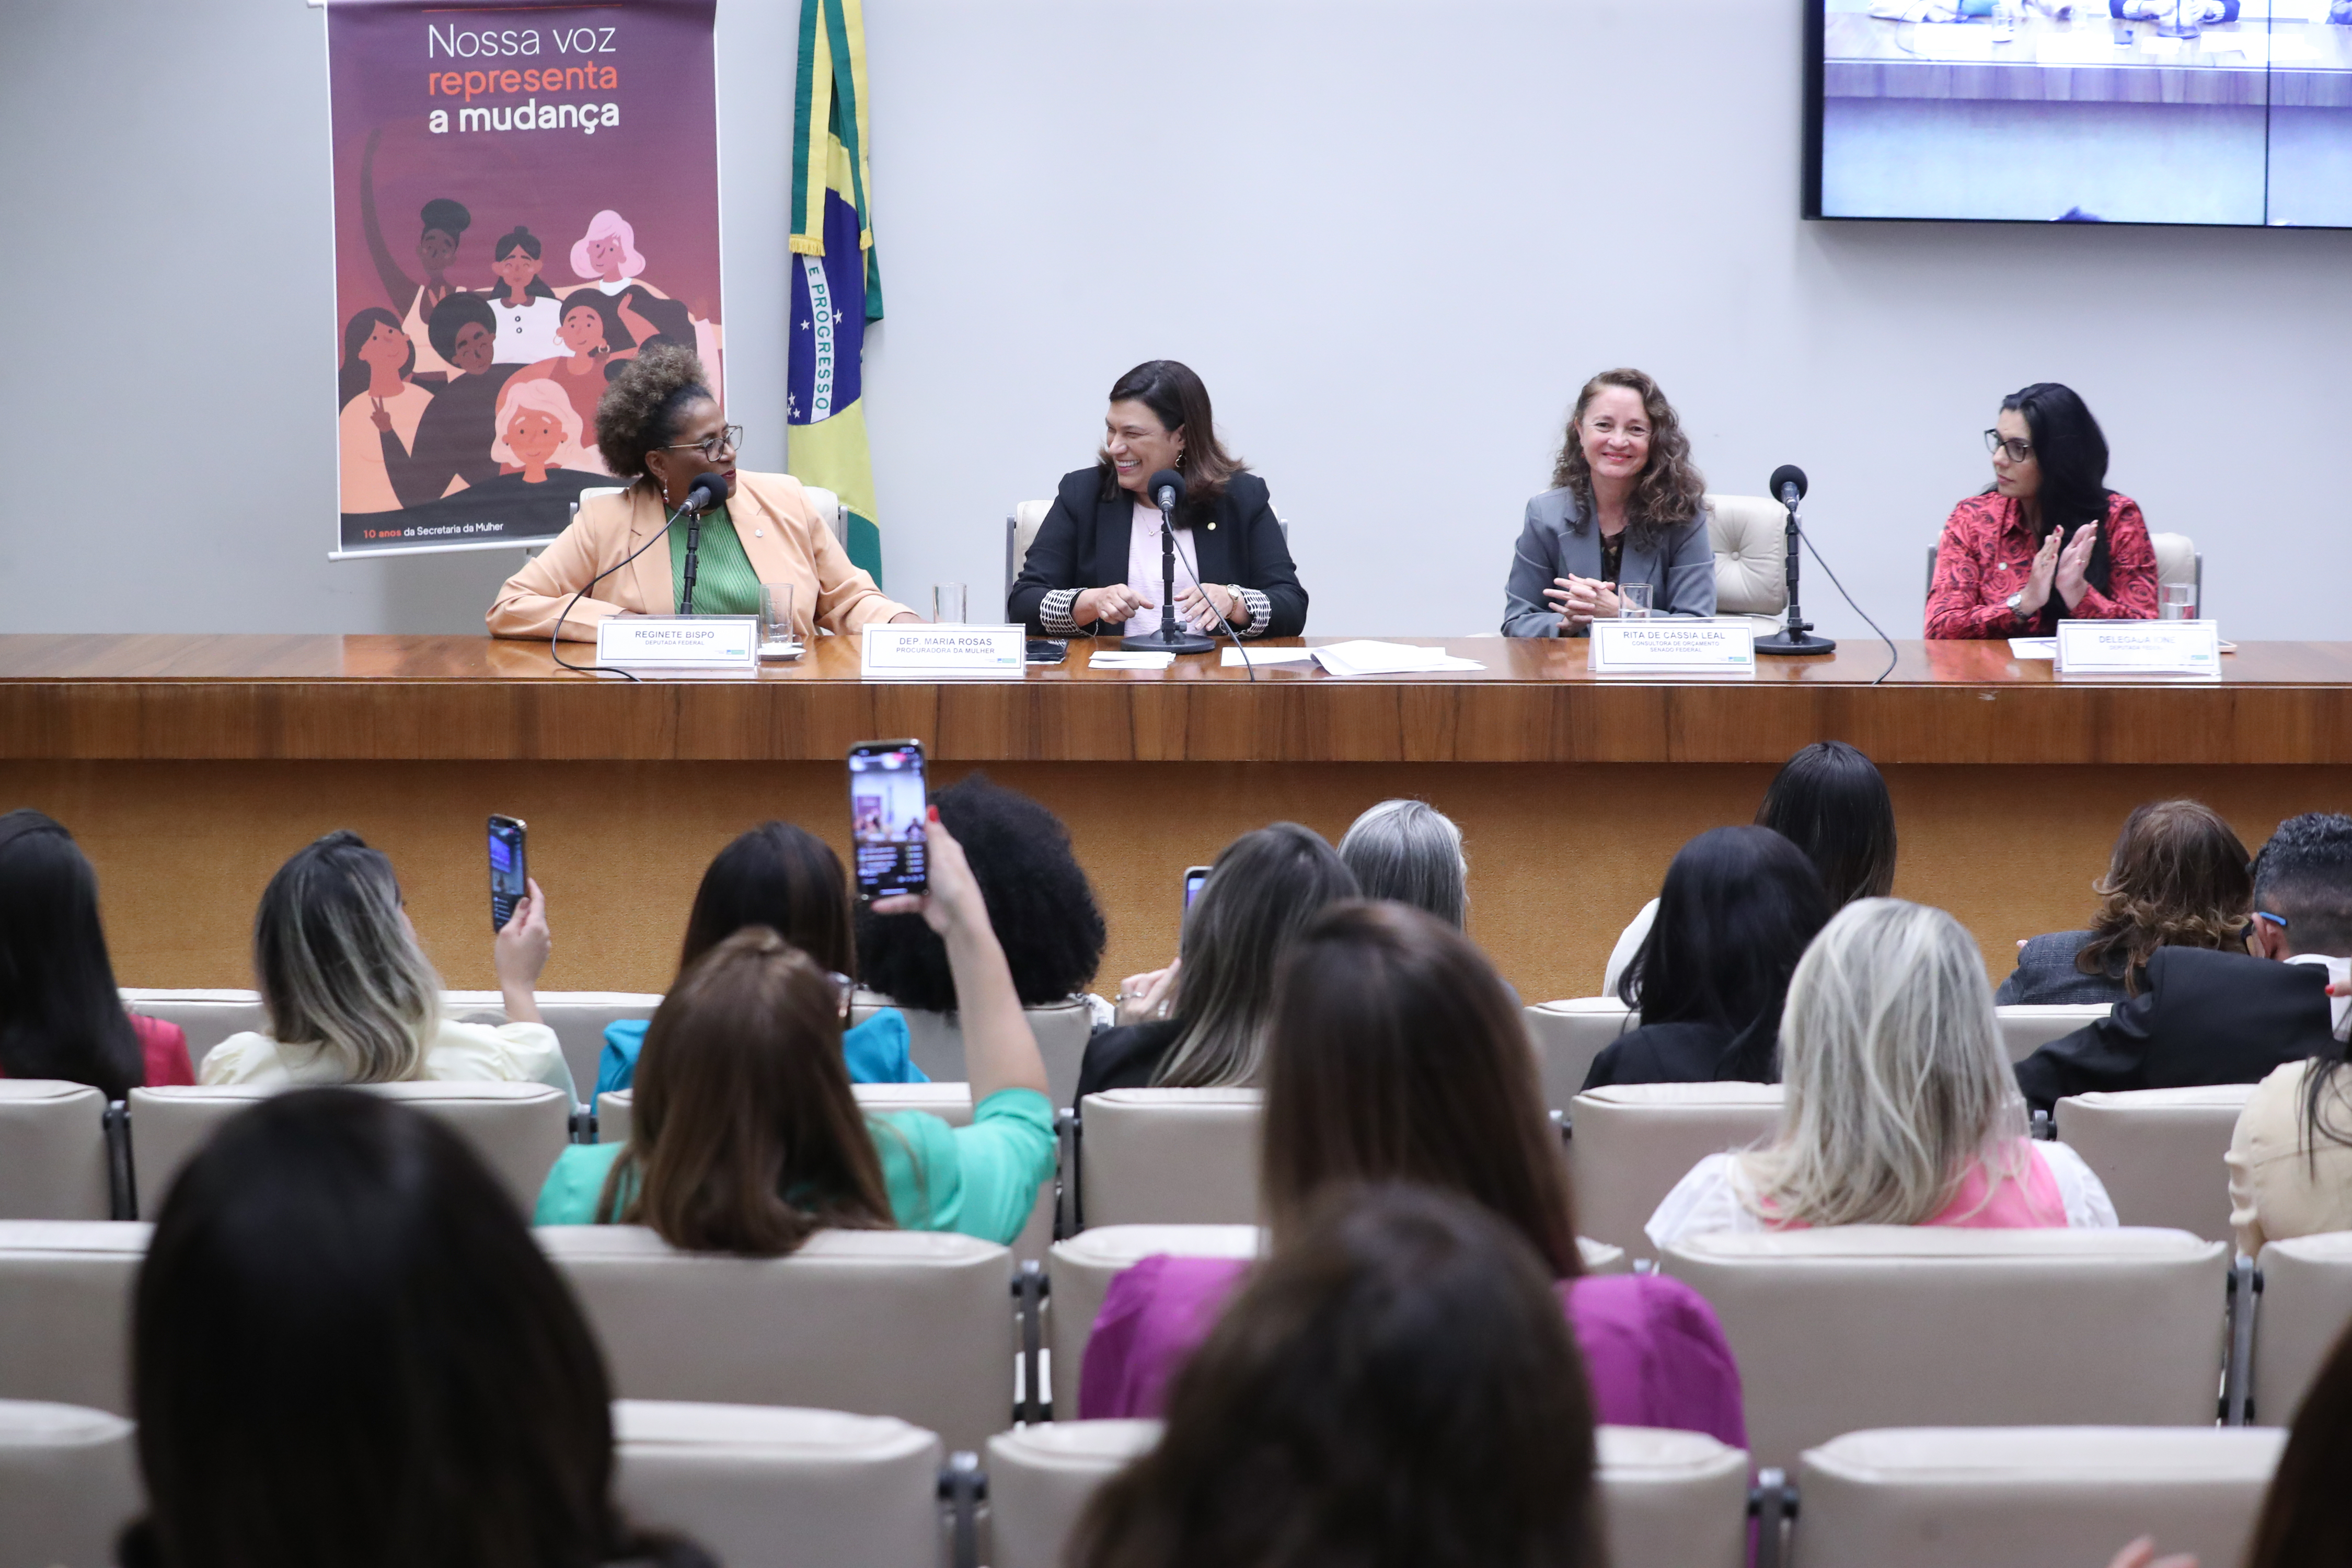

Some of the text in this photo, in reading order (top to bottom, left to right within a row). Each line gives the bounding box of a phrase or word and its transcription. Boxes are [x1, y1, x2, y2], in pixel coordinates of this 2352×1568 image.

[429, 24, 616, 59] Nossa voz
[429, 60, 618, 102] representa
[429, 98, 619, 134] a mudança
[808, 267, 831, 410] E PROGRESSO
[364, 529, 376, 538] 10
[404, 527, 415, 536] da
[417, 524, 461, 535] Secretaria
[463, 524, 474, 533] da
[476, 522, 504, 532] Mulher
[1664, 630, 1698, 639] CÁSSIA
